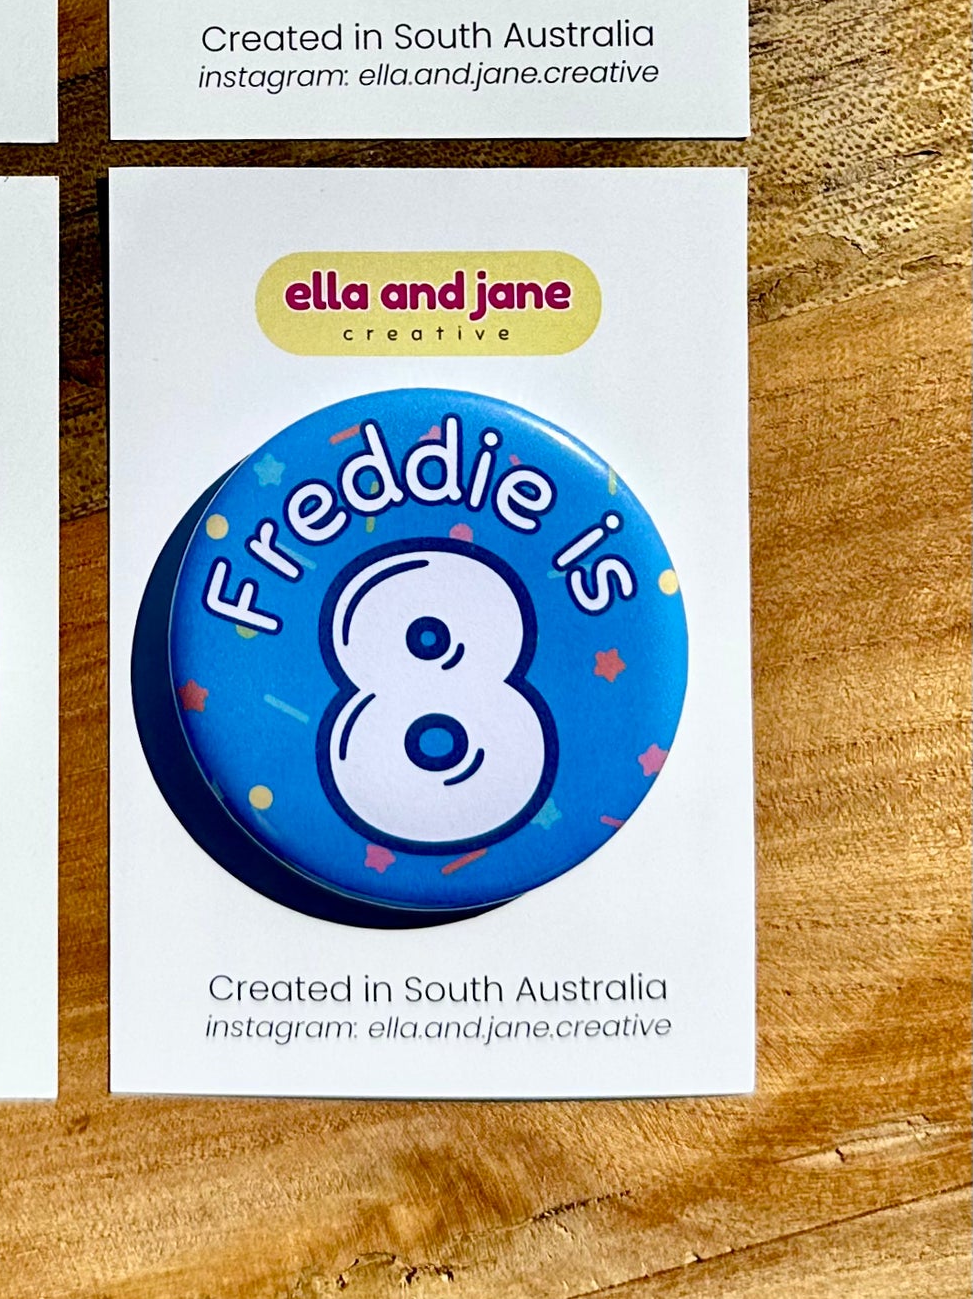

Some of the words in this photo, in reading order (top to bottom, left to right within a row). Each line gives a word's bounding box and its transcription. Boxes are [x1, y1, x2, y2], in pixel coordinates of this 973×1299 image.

[201, 24, 342, 52] Created
[355, 24, 383, 50] in
[394, 22, 492, 50] South
[503, 20, 654, 50] Australia
[199, 64, 349, 94] instagram:
[359, 60, 659, 92] ella.and.jane.creative
[285, 270, 369, 311] ella
[381, 270, 465, 310] and
[469, 270, 571, 321] jane
[343, 324, 510, 342] creative
[202, 413, 557, 635] Freddie
[551, 510, 637, 616] is
[315, 536, 560, 856] 8
[209, 974, 351, 1002] Created
[365, 974, 393, 1002] in
[405, 974, 503, 1003] South
[515, 972, 667, 1002] Australia
[205, 1014, 357, 1045] instagram:
[369, 1014, 672, 1045] ella.and.jane.creative
